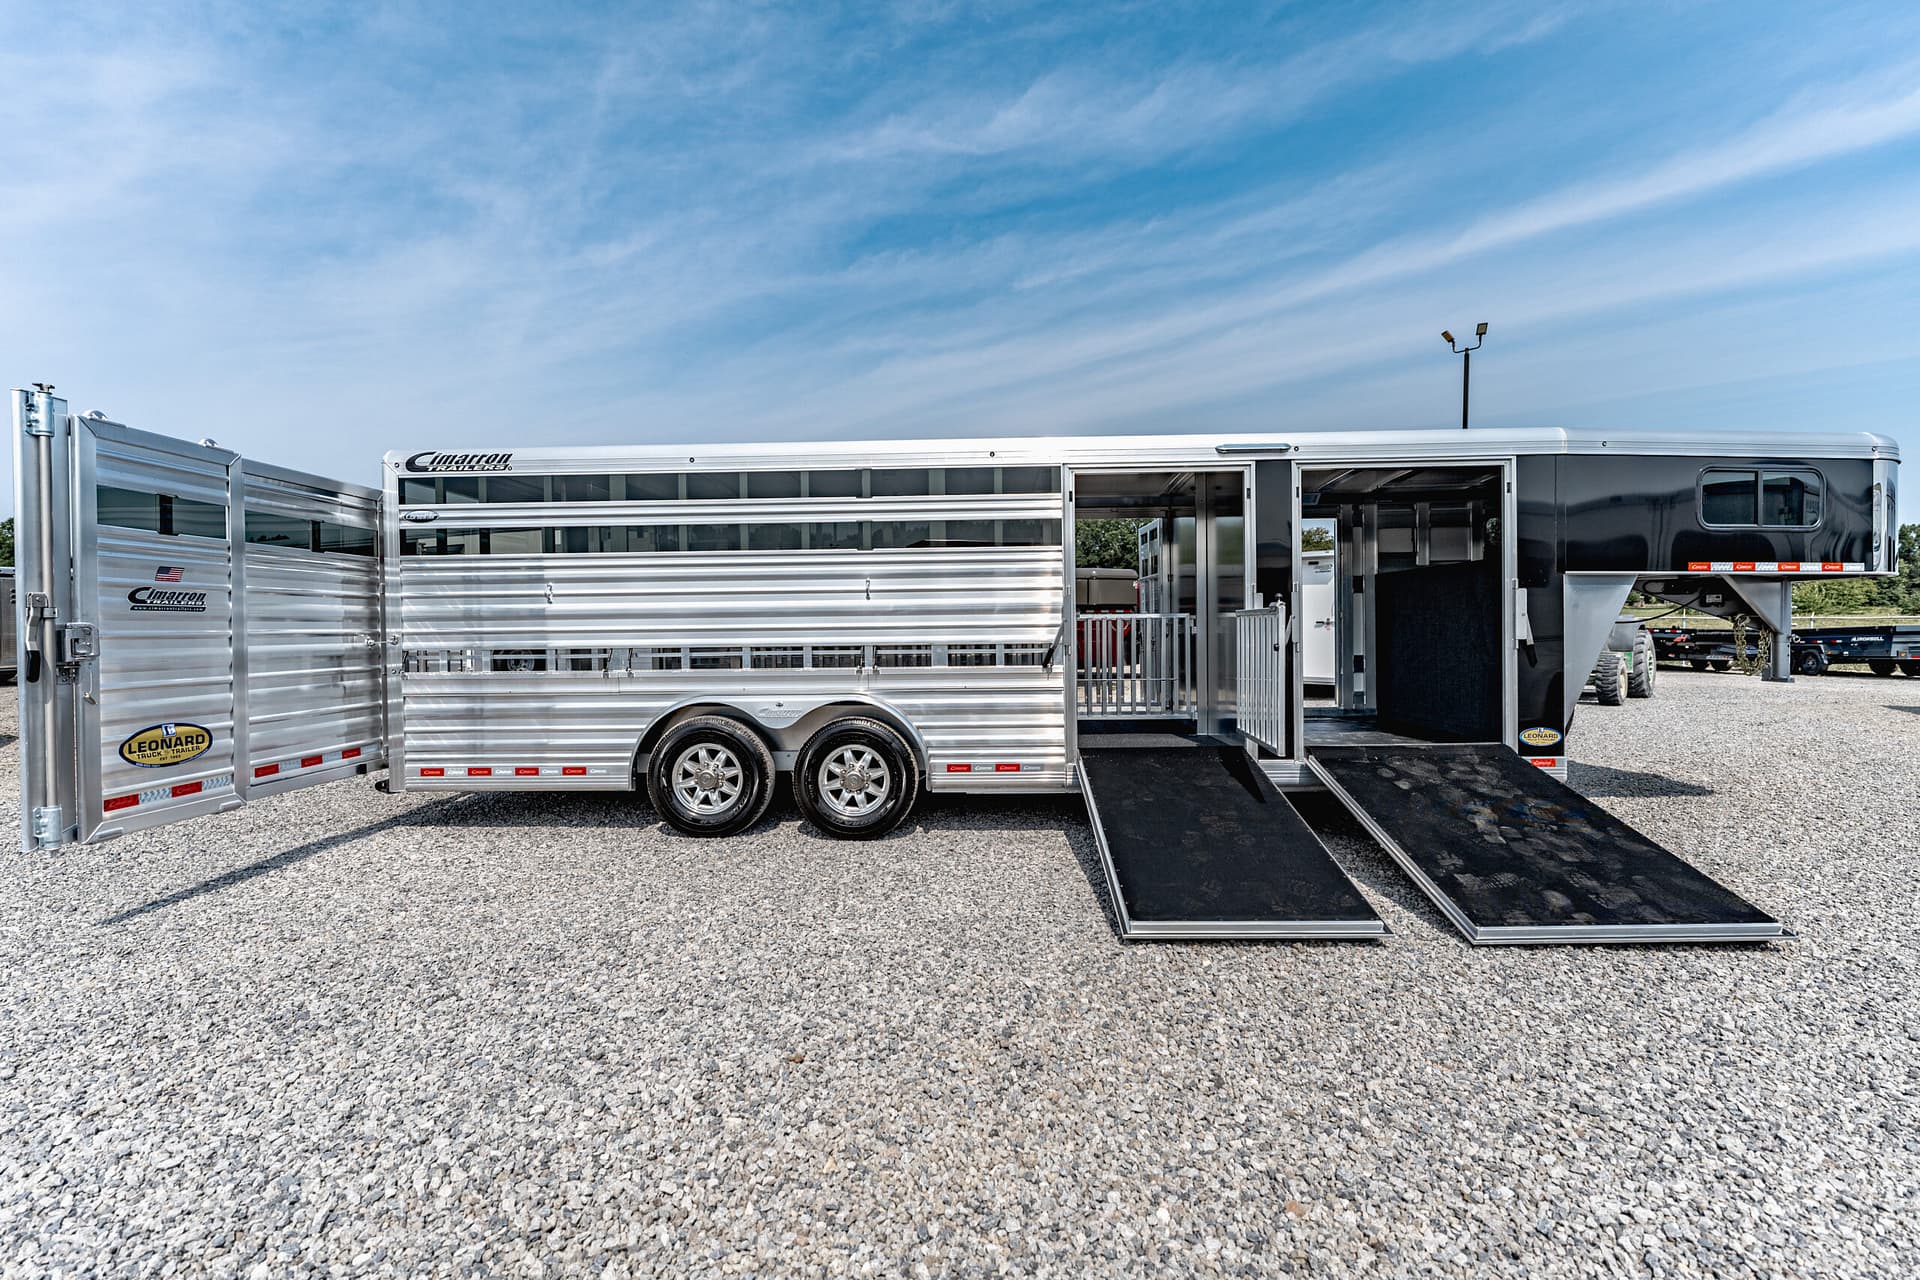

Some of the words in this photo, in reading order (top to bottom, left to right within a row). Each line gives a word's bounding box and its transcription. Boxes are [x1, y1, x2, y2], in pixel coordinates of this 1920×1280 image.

[405, 451, 513, 472] Cimarron
[427, 464, 508, 472] TRAILERS
[128, 587, 206, 604] Cimarron
[127, 734, 206, 755] LEONARD
[136, 751, 162, 760] TRUCK
[171, 746, 201, 755] TRAILER
